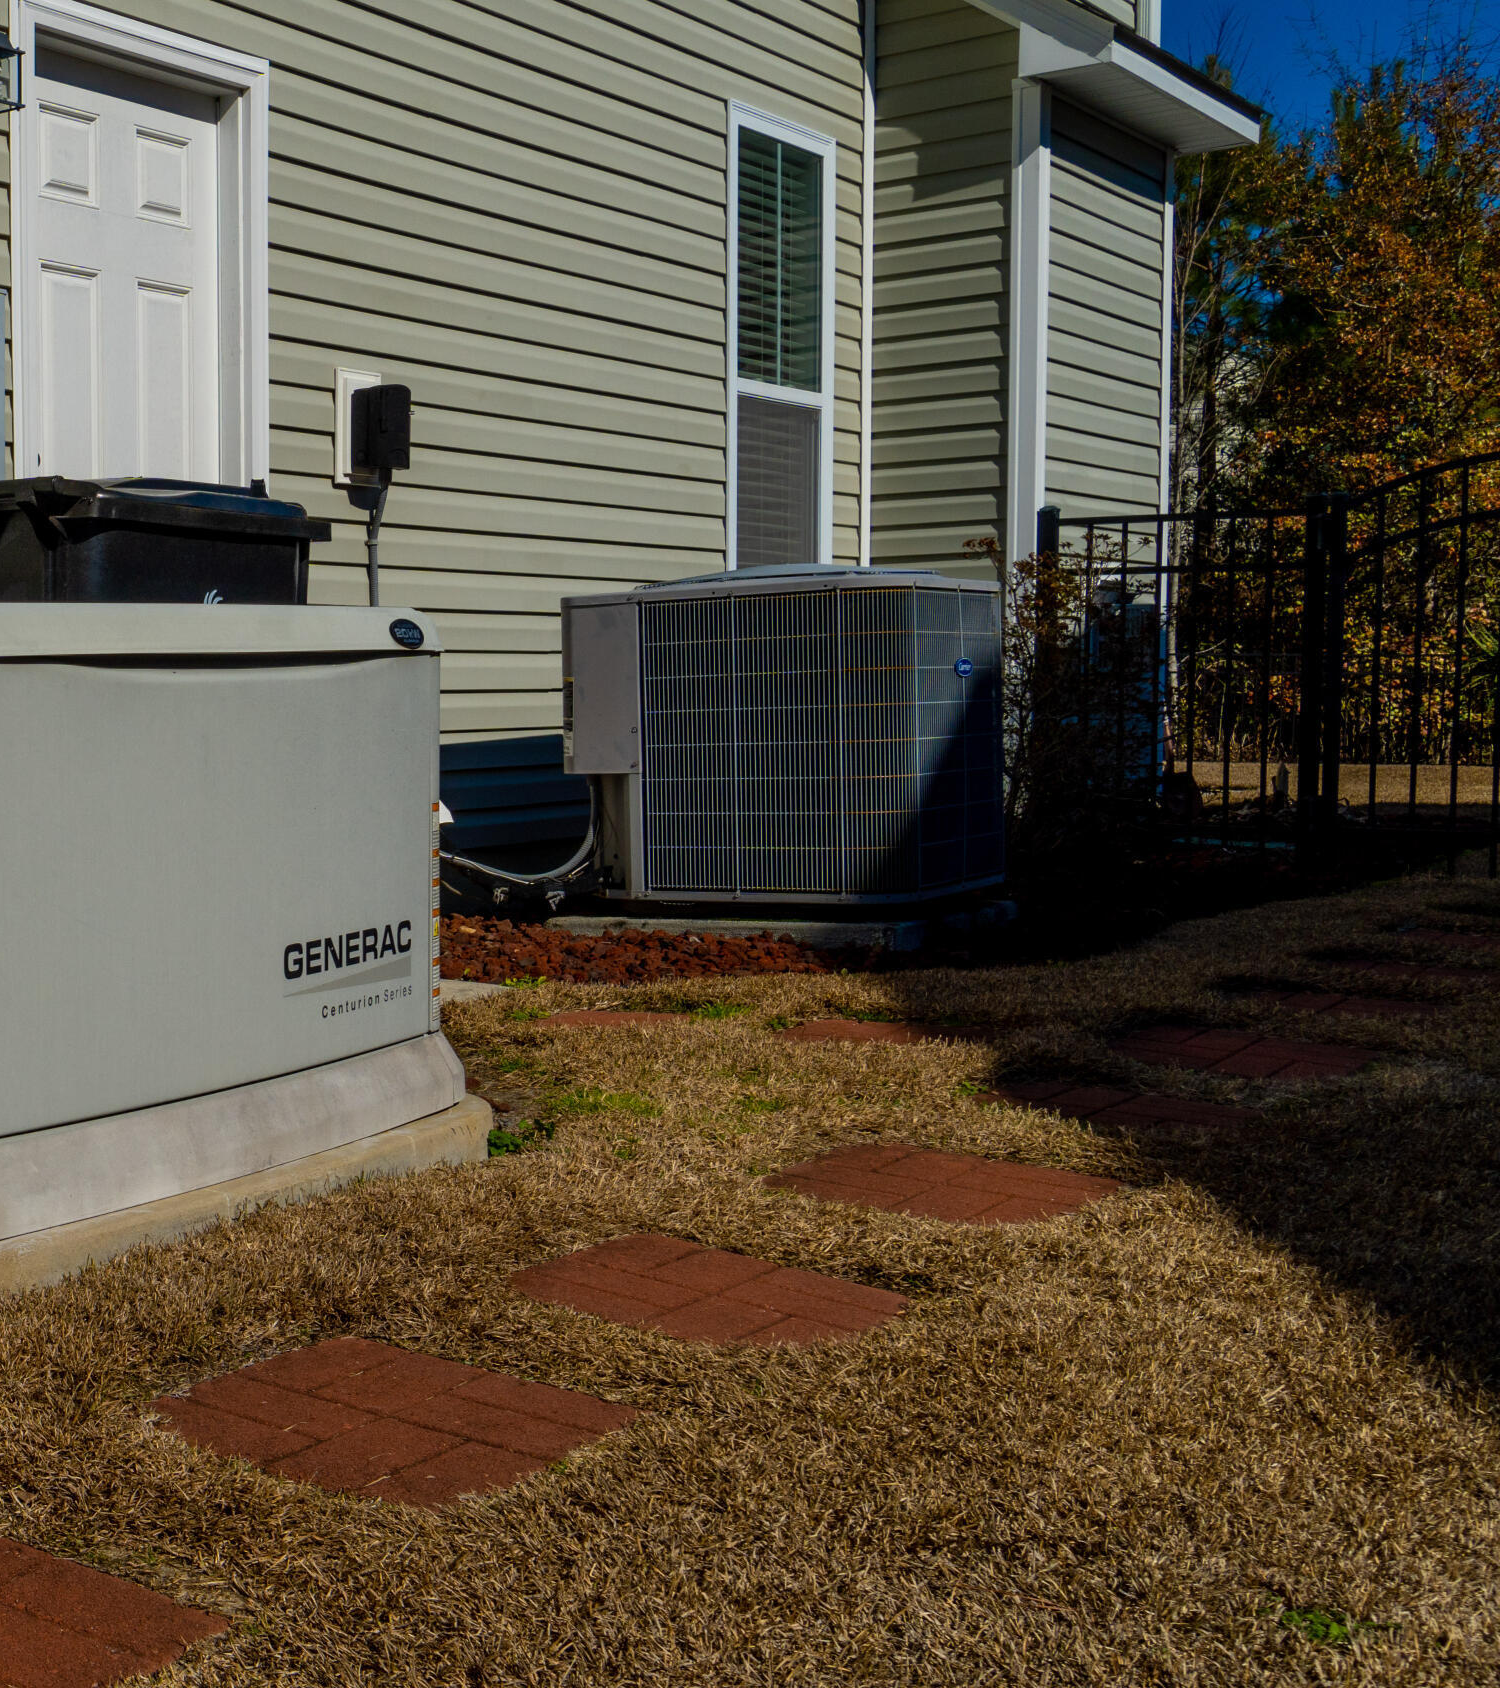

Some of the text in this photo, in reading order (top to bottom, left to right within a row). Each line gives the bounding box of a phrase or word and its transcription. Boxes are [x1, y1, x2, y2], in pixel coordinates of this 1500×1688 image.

[284, 920, 412, 980] GENERAC
[322, 985, 412, 1019] Centurion Series
